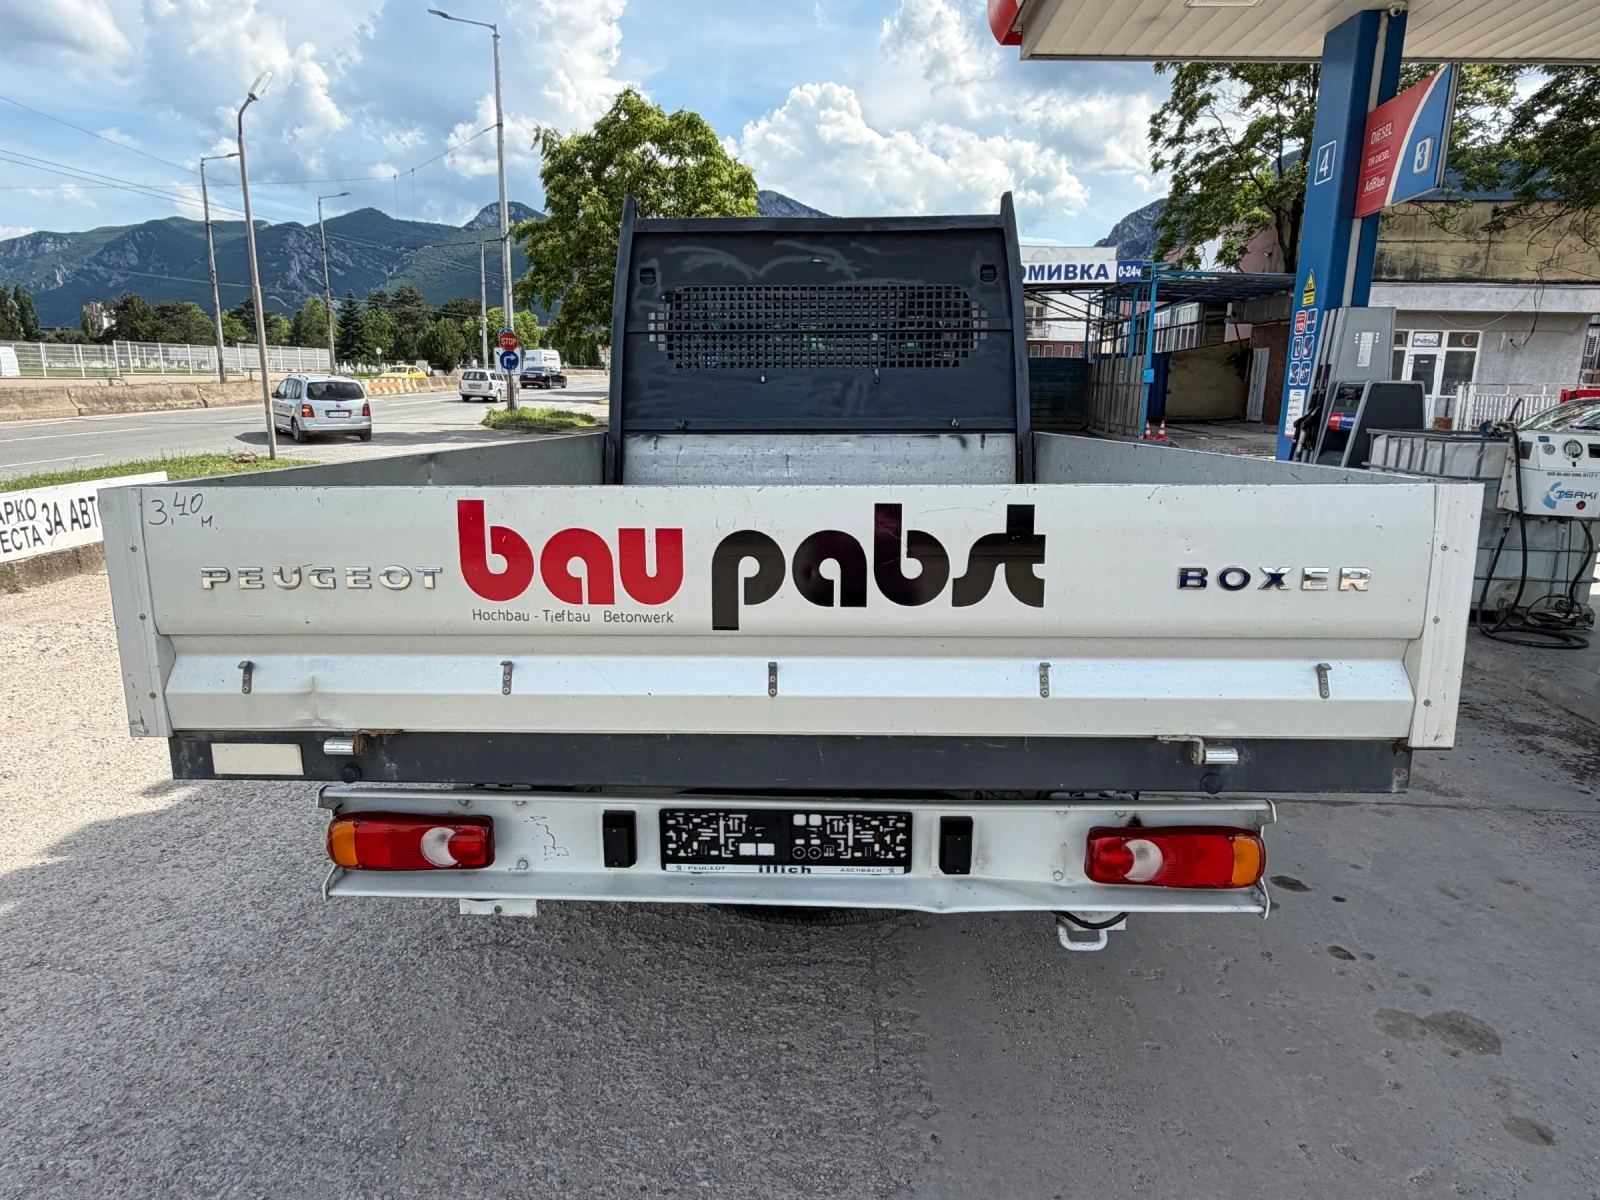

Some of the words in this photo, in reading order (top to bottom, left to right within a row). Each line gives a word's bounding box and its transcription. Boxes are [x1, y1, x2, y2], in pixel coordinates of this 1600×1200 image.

[1371, 123, 1393, 145] DIESEL
[1319, 149, 1329, 177] 4
[1375, 150, 1390, 164] DIESEL
[1417, 142, 1427, 170] 3
[1364, 176, 1386, 193] AdBlue
[1118, 265, 1142, 278] 0-24ч
[501, 337, 517, 346] STOP
[41, 502, 67, 536] ЗА
[457, 500, 684, 605] bau
[712, 503, 1046, 630] pabst
[200, 565, 443, 591] PEUGEOT
[1177, 565, 1373, 592] BOXER
[472, 609, 530, 622] Hochbau
[542, 609, 591, 623] Tiefbau
[603, 610, 674, 623] Betonwerk
[758, 865, 812, 874] illich
